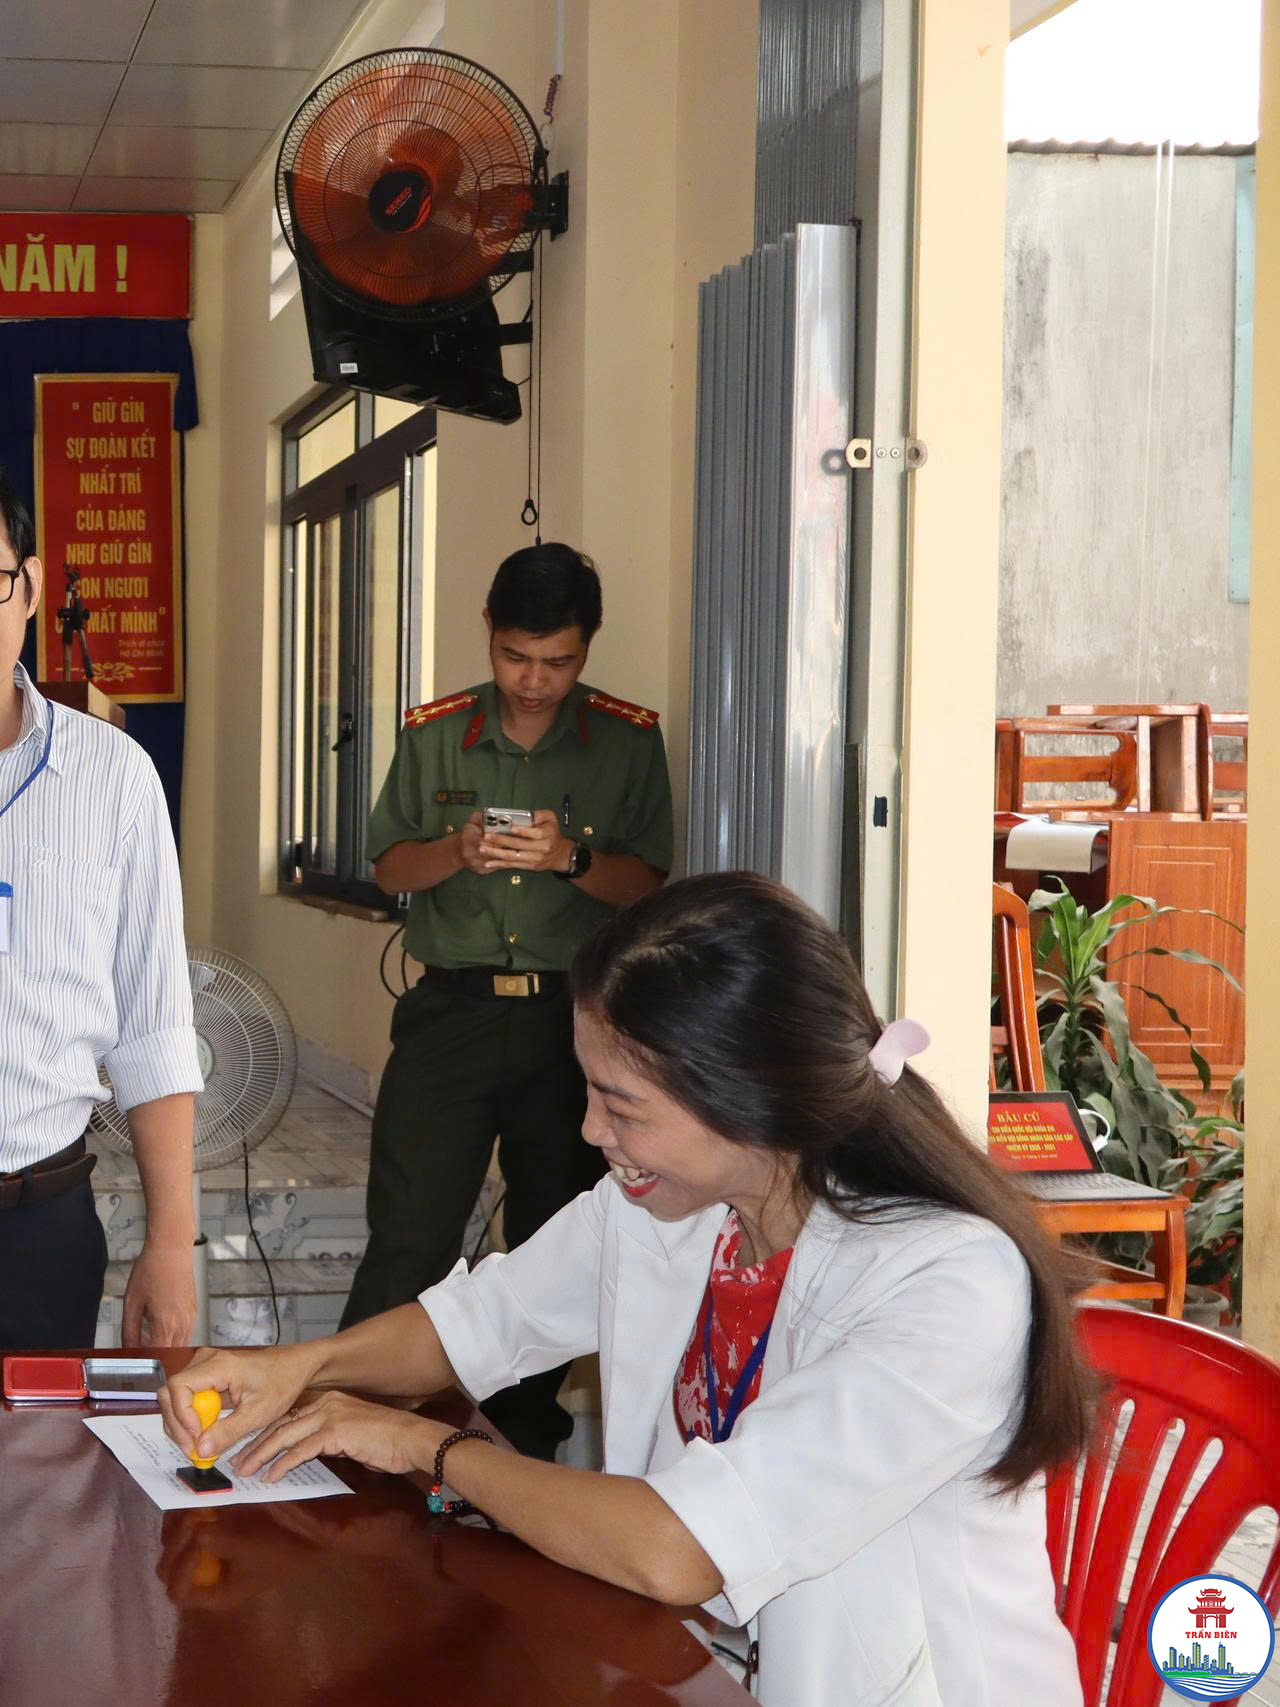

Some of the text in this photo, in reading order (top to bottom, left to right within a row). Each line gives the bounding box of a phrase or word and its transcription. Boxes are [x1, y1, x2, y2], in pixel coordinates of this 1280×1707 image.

[115, 245, 128, 292] !
[93, 397, 118, 423] GIỮ
[121, 396, 144, 423] GÌN
[66, 428, 157, 464] SỰ ĐOÀN KẾT
[80, 464, 141, 495] NHẤT TRÍ
[76, 504, 146, 531] CỦA ĐẢNG
[66, 543, 97, 565] NHƯ
[127, 538, 153, 565] GÌN
